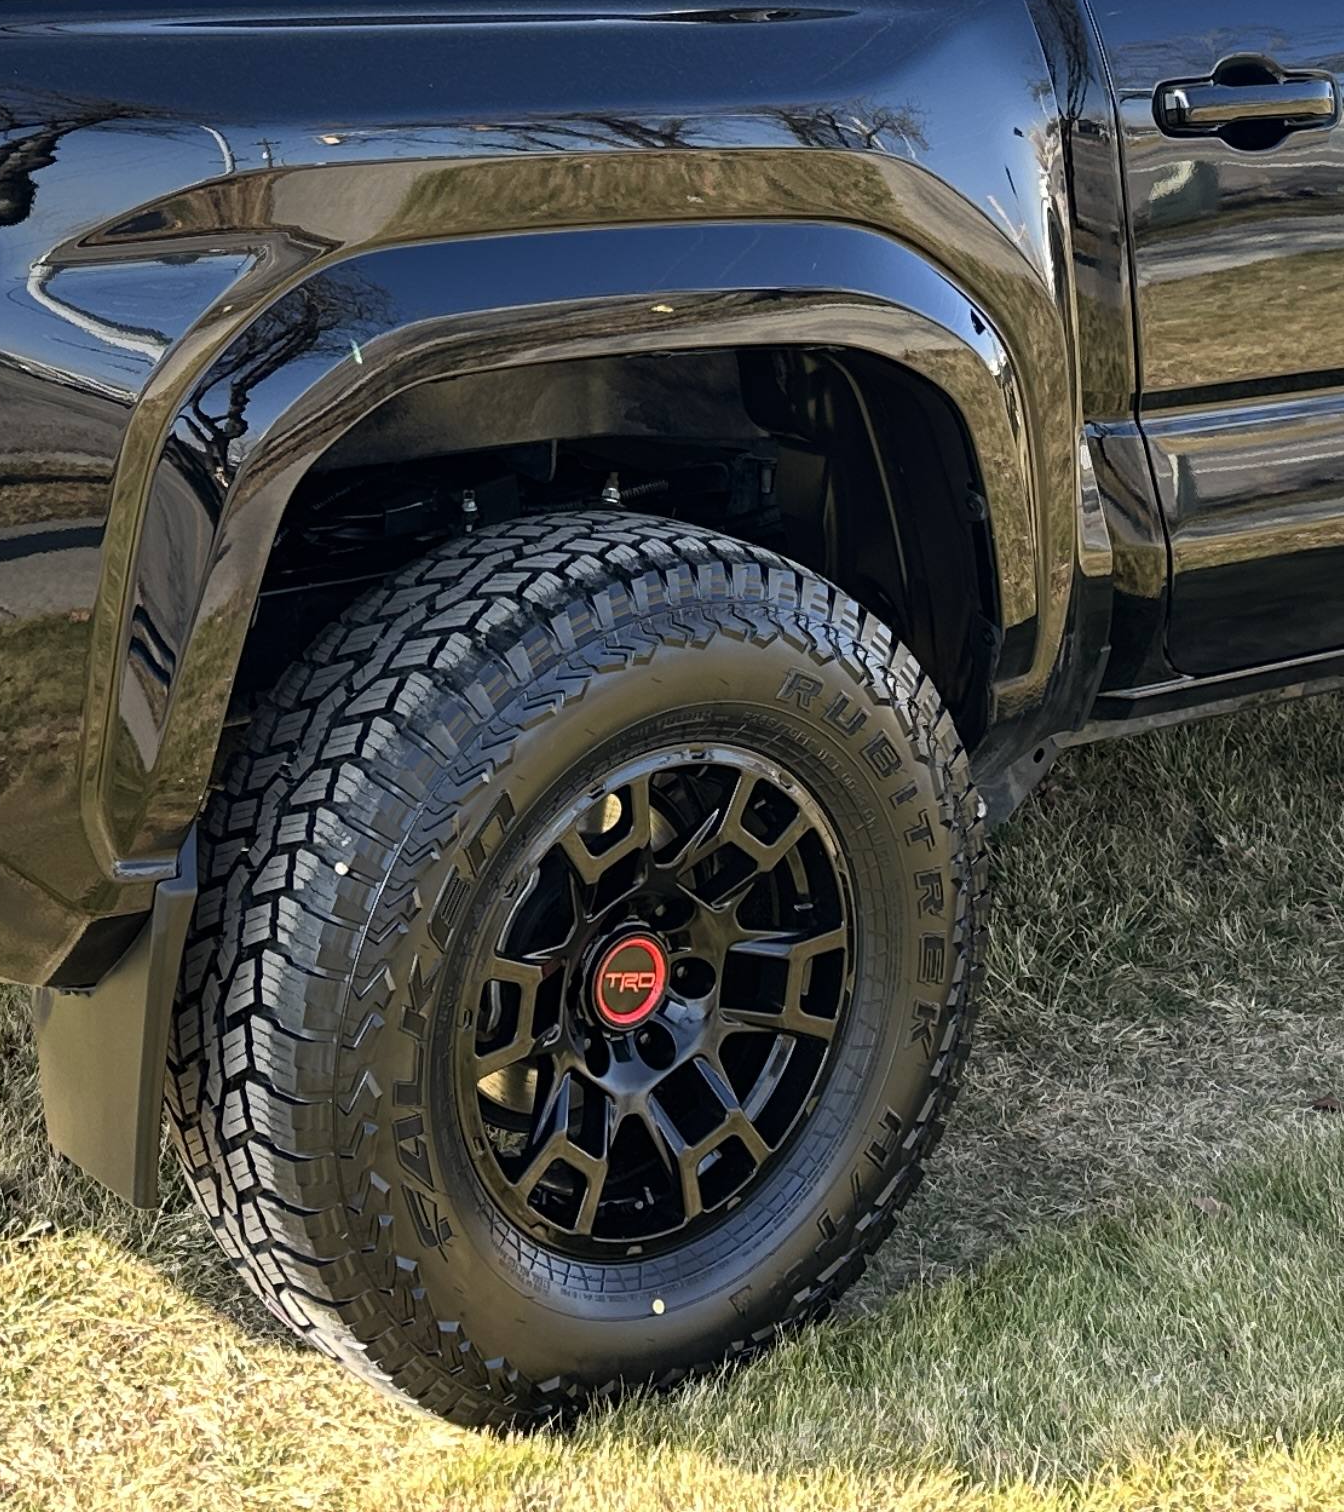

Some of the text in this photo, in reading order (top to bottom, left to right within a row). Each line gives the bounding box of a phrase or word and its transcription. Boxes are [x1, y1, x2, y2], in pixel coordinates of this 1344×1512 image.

[393, 789, 518, 1264] FALKEN
[604, 971, 656, 994] TRD
[775, 666, 947, 1060] RUBITREK
